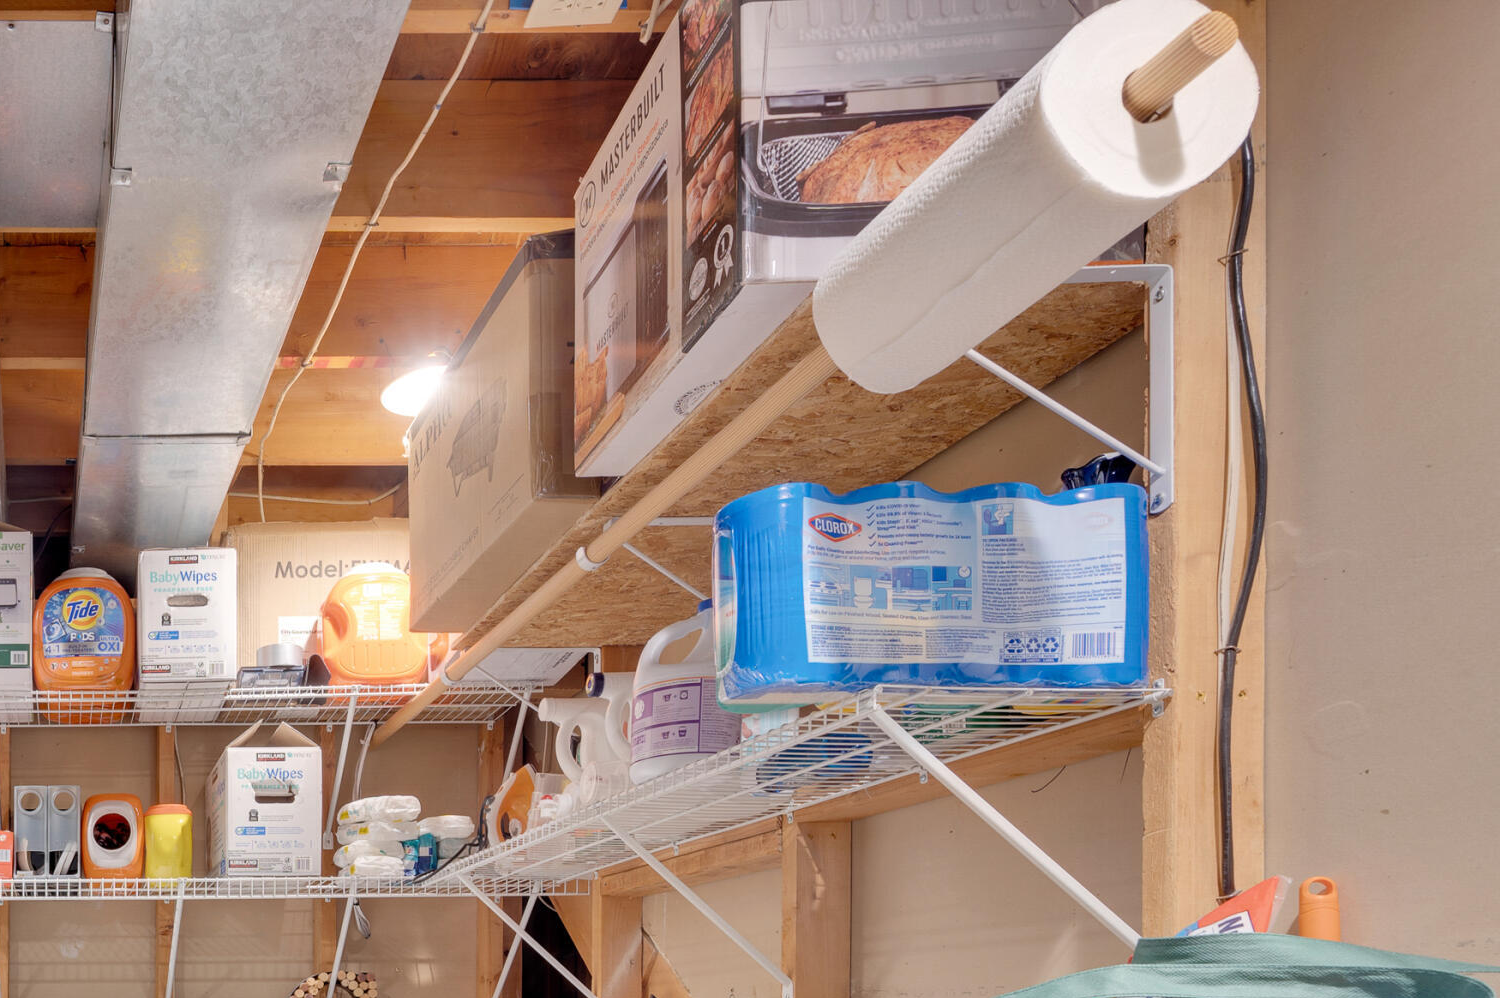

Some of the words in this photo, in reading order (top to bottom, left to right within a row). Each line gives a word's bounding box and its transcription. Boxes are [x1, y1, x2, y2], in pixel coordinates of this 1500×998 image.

[601, 64, 665, 192] MASTERBUILT
[814, 518, 855, 535] CLOROX
[67, 600, 100, 624] Tide
[97, 641, 120, 652] OXI
